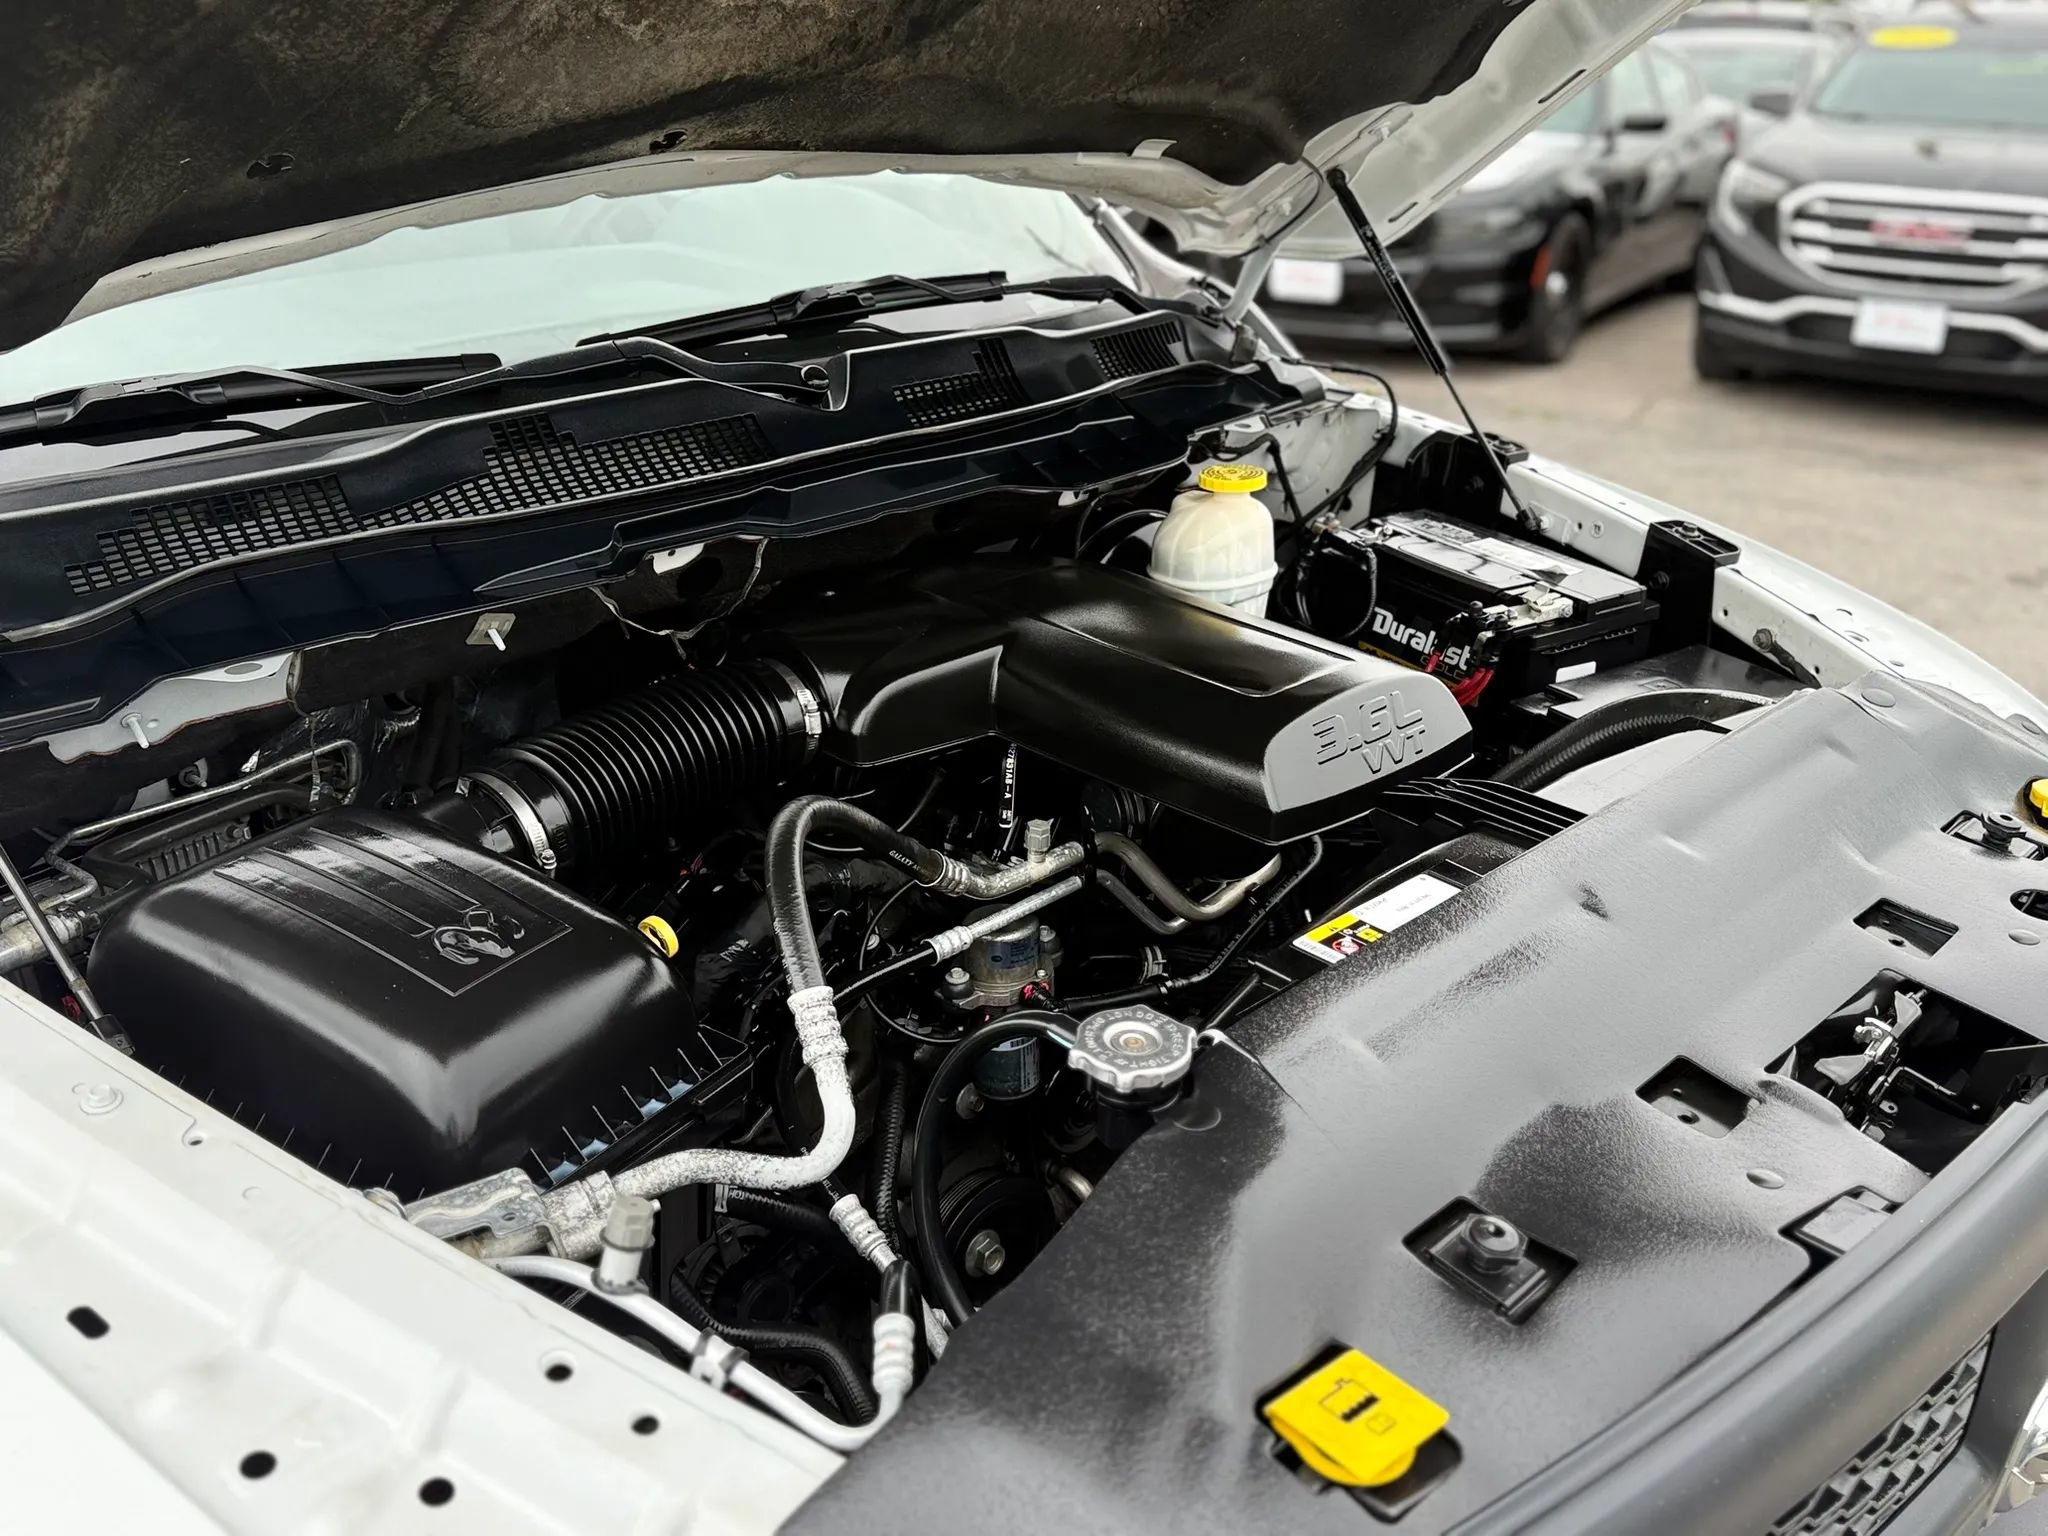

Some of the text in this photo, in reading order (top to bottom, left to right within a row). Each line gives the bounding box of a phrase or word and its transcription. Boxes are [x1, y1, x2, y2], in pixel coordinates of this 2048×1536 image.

[1372, 606, 1471, 671] Duralst
[1312, 690, 1423, 765] 3.6L
[1361, 725, 1426, 774] VVT
[1128, 1056, 1171, 1068] TIGHT
